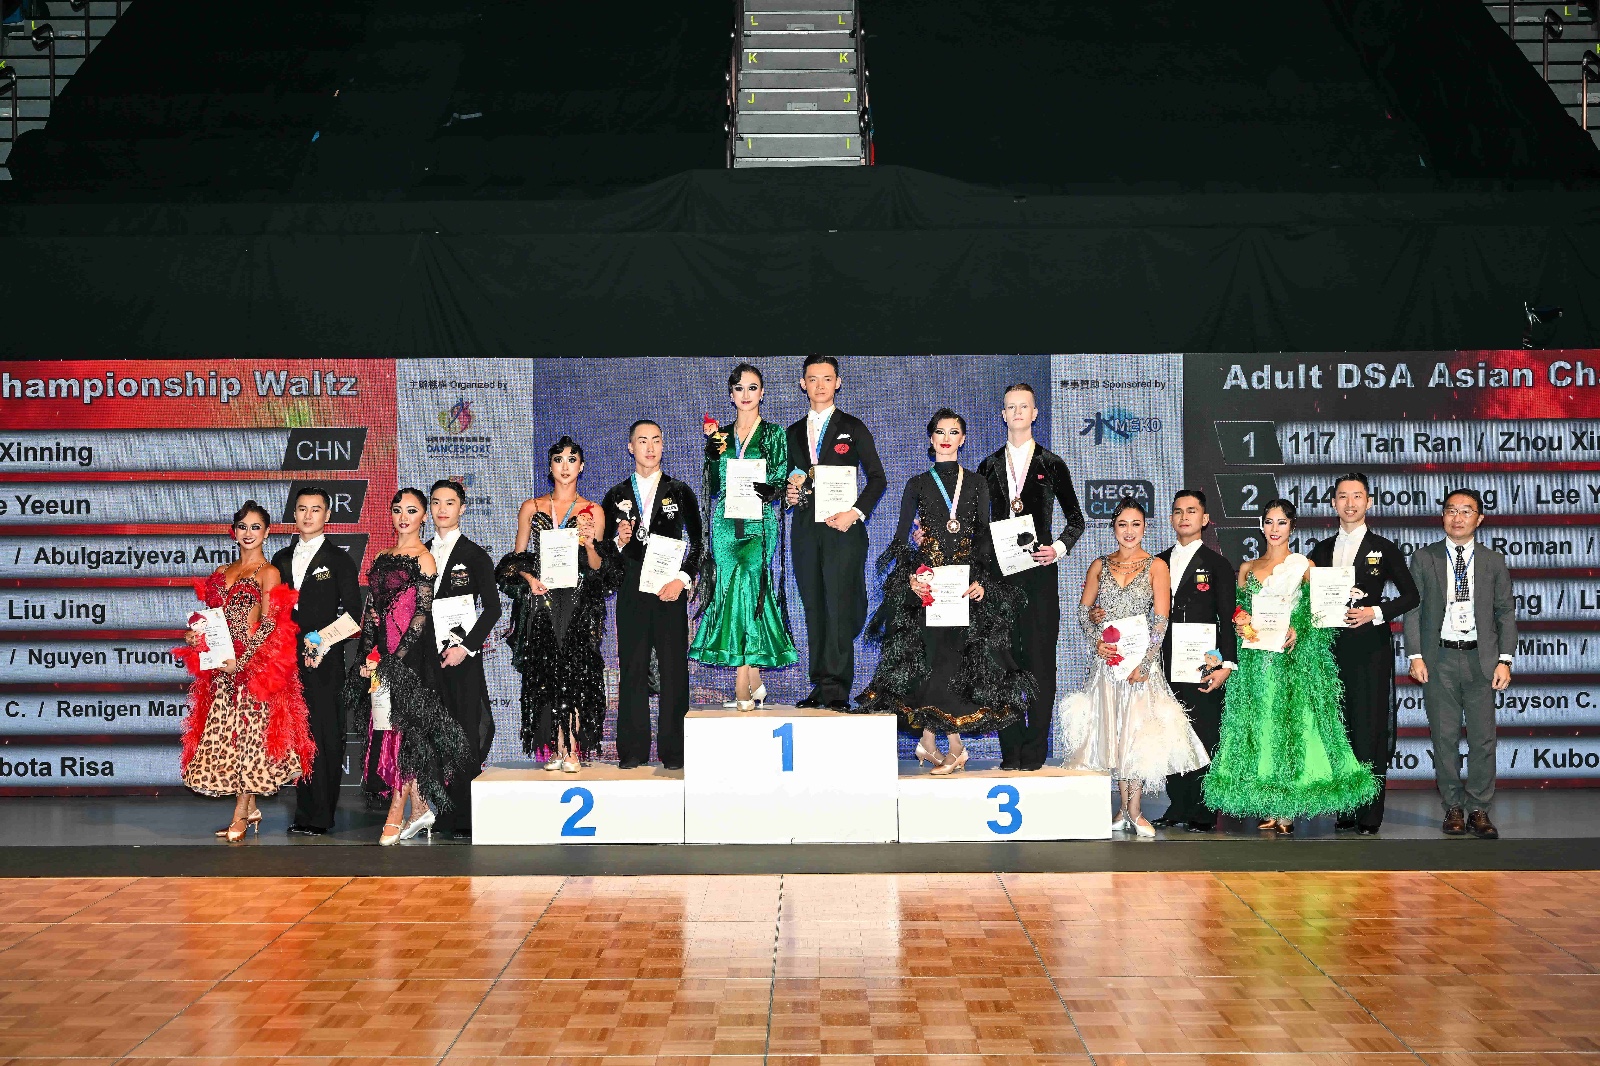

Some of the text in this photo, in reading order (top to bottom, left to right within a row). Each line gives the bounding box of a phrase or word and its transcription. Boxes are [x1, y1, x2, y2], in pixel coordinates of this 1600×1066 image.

[751, 16, 758, 25] L
[838, 15, 845, 24] L
[748, 53, 757, 63] K
[840, 53, 848, 63] K
[748, 93, 755, 104] J
[844, 93, 850, 102] J
[450, 380, 494, 390] Organized
[1103, 380, 1166, 390] Sponsored by
[1222, 360, 1600, 390] Adult DSA Asian Ch
[2, 369, 358, 404] hampionship Waltz
[296, 440, 351, 461] CHN
[1242, 432, 1254, 457] 1
[1288, 432, 1335, 454] 117
[1361, 433, 1404, 453] Tan
[1414, 432, 1461, 452] Ran
[1477, 432, 1484, 451] /
[1499, 431, 1562, 451] Zhou
[0, 442, 93, 466] Xinning
[1090, 484, 1149, 500] MEGA
[1241, 484, 1258, 510] 2
[1436, 486, 1498, 510] Jg
[1512, 485, 1520, 504] /
[1537, 484, 1580, 504] Lee
[15, 494, 91, 515] Yeeun
[1242, 537, 1260, 562] 3
[1492, 537, 1572, 555] Roman
[1587, 536, 1594, 554] /
[14, 545, 241, 570] / Abulgaziyeva Ami
[1557, 590, 1564, 609] /
[8, 600, 106, 625] Liu Jing
[1519, 639, 1587, 656] Minh /
[10, 650, 16, 665] /
[28, 648, 107, 670] Nguyen
[5, 701, 190, 722] C. / Renigen Mar
[1495, 692, 1597, 713] Jayson C.
[772, 723, 794, 771] 1
[60, 756, 114, 777] Risa
[1510, 749, 1518, 768] /
[1534, 748, 1600, 769] Kubo
[560, 788, 596, 837] 2
[986, 784, 1023, 834] 3
